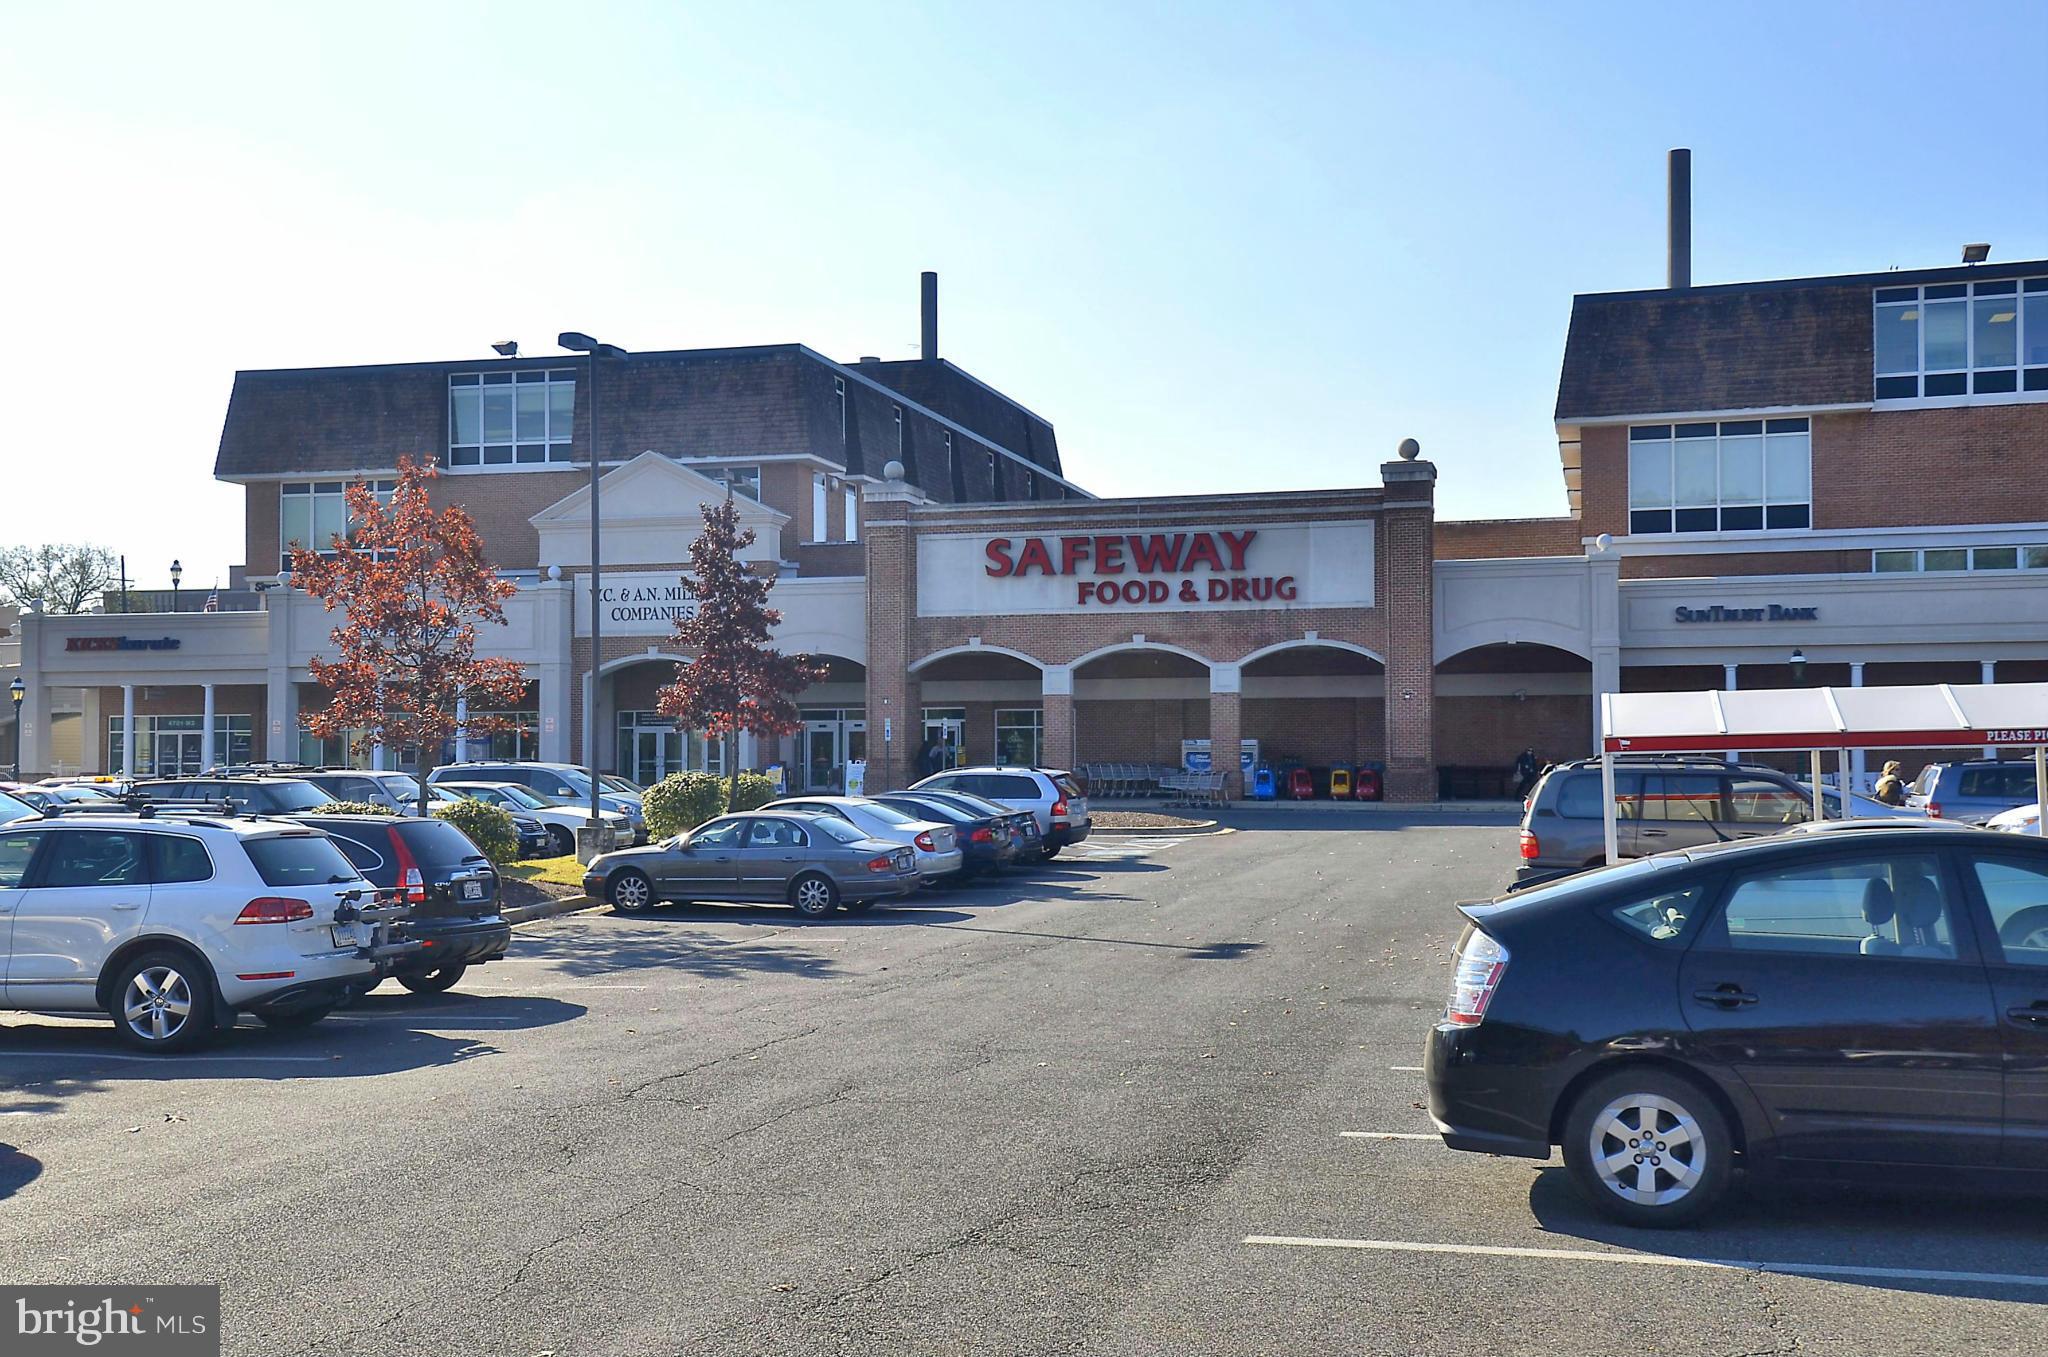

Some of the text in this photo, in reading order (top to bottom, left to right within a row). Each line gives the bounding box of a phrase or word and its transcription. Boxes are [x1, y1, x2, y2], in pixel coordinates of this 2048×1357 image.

[985, 531, 1258, 577] SAFEWAY
[620, 588, 630, 601] &
[634, 587, 661, 602] A.N.
[1077, 576, 1297, 605] FOOD & DRUG
[611, 606, 694, 622] COMPANIES
[1986, 730, 2032, 741] PLEASE
